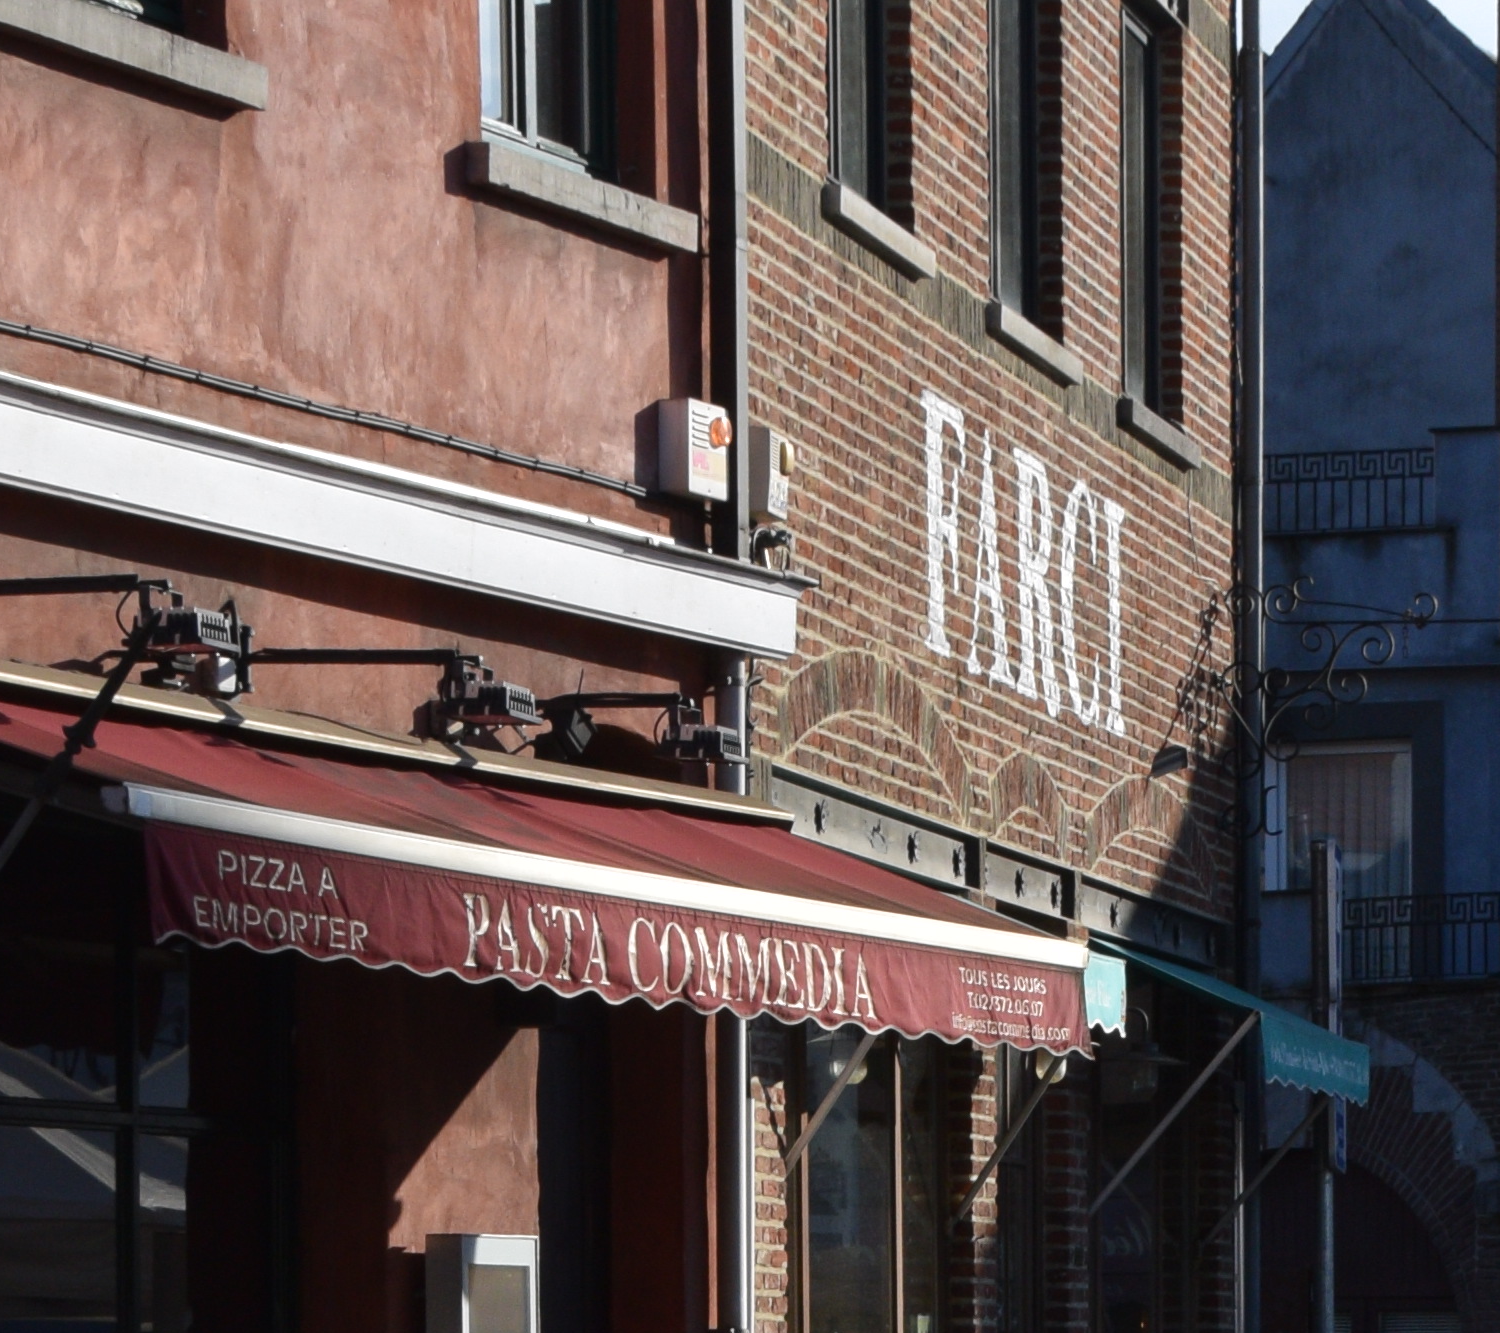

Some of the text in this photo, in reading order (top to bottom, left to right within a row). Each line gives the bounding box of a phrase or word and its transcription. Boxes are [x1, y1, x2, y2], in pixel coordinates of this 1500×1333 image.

[216, 849, 338, 898] PIZZA A
[191, 894, 370, 953] EMPORTER
[461, 890, 877, 1022] PASTA COMMEDIA
[959, 966, 1047, 995] TOUS LES JOURS
